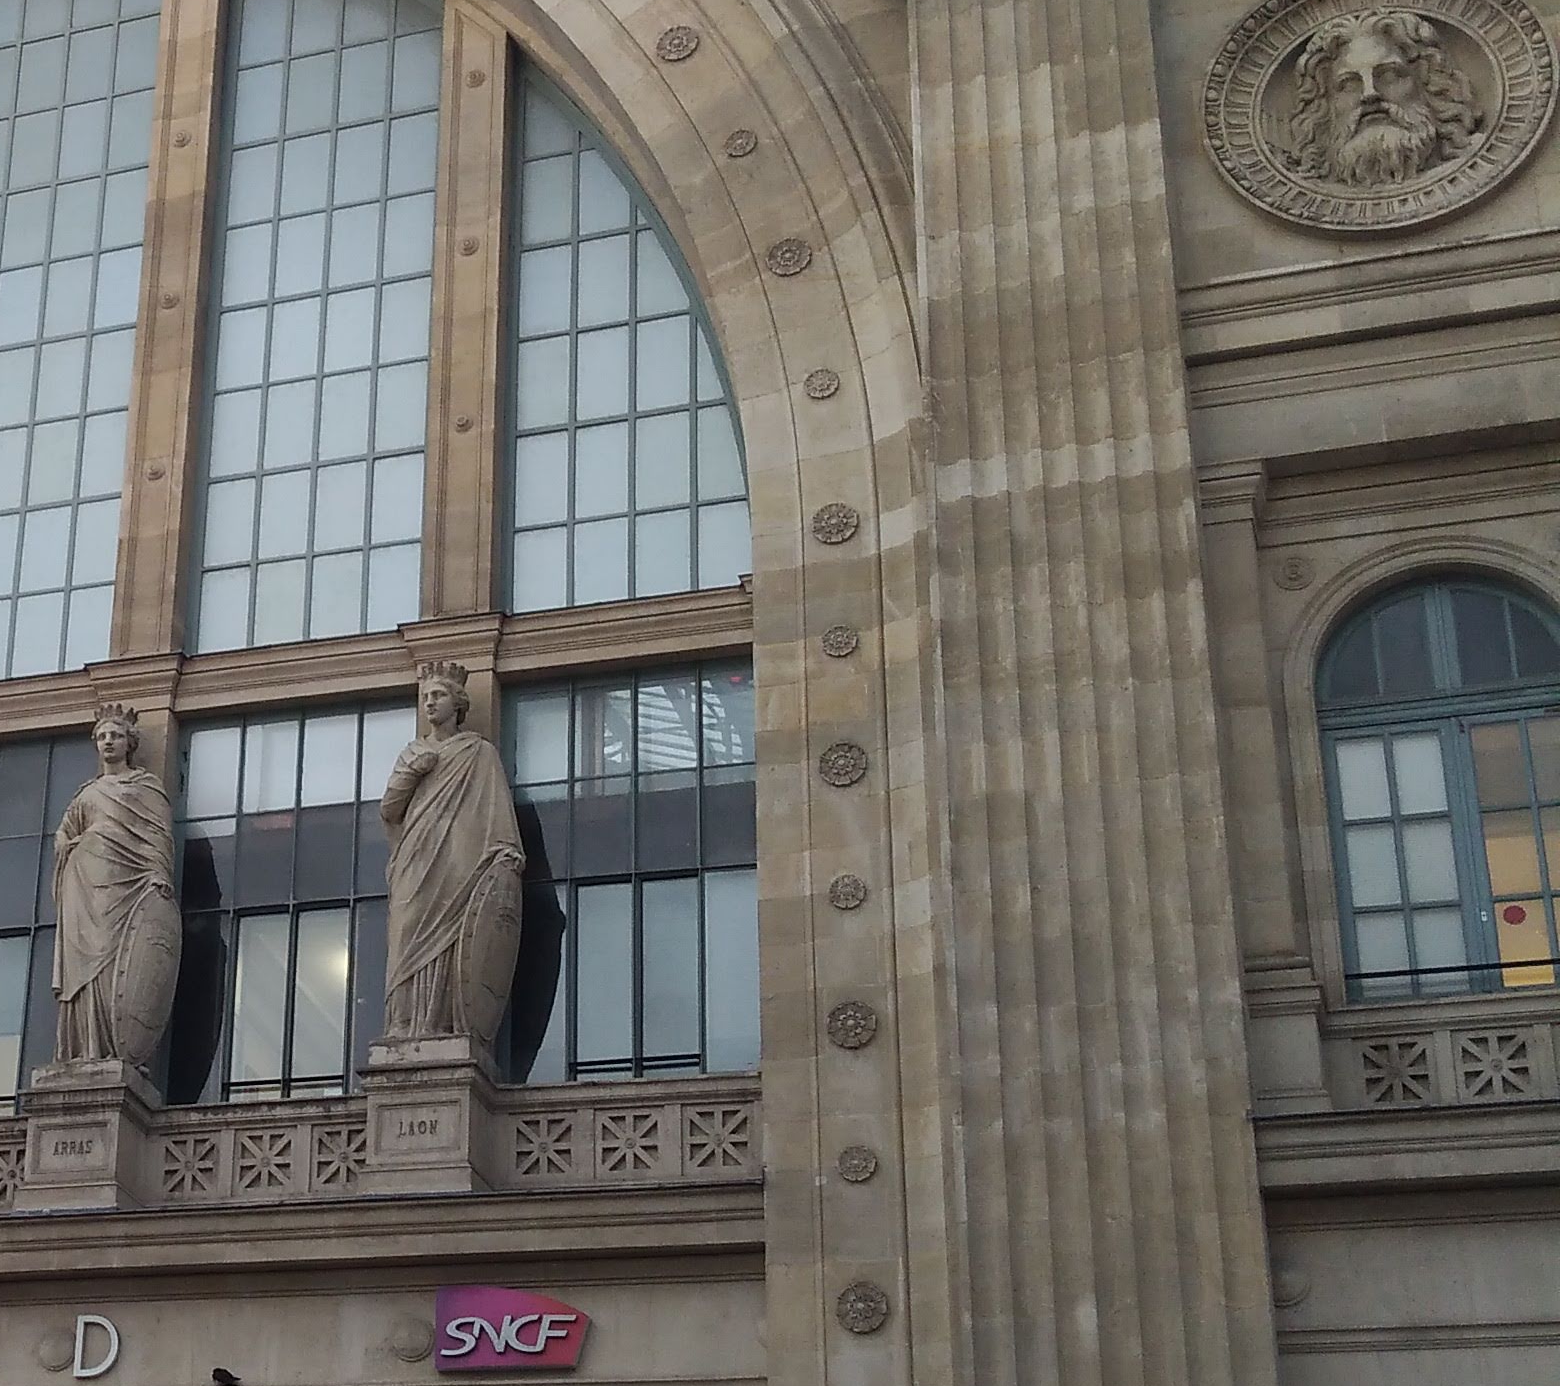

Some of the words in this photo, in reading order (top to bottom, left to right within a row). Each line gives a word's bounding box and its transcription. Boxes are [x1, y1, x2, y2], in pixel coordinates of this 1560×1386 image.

[398, 1119, 438, 1138] LAON
[52, 1140, 93, 1156] ARRAS
[439, 1313, 577, 1357] SNCF
